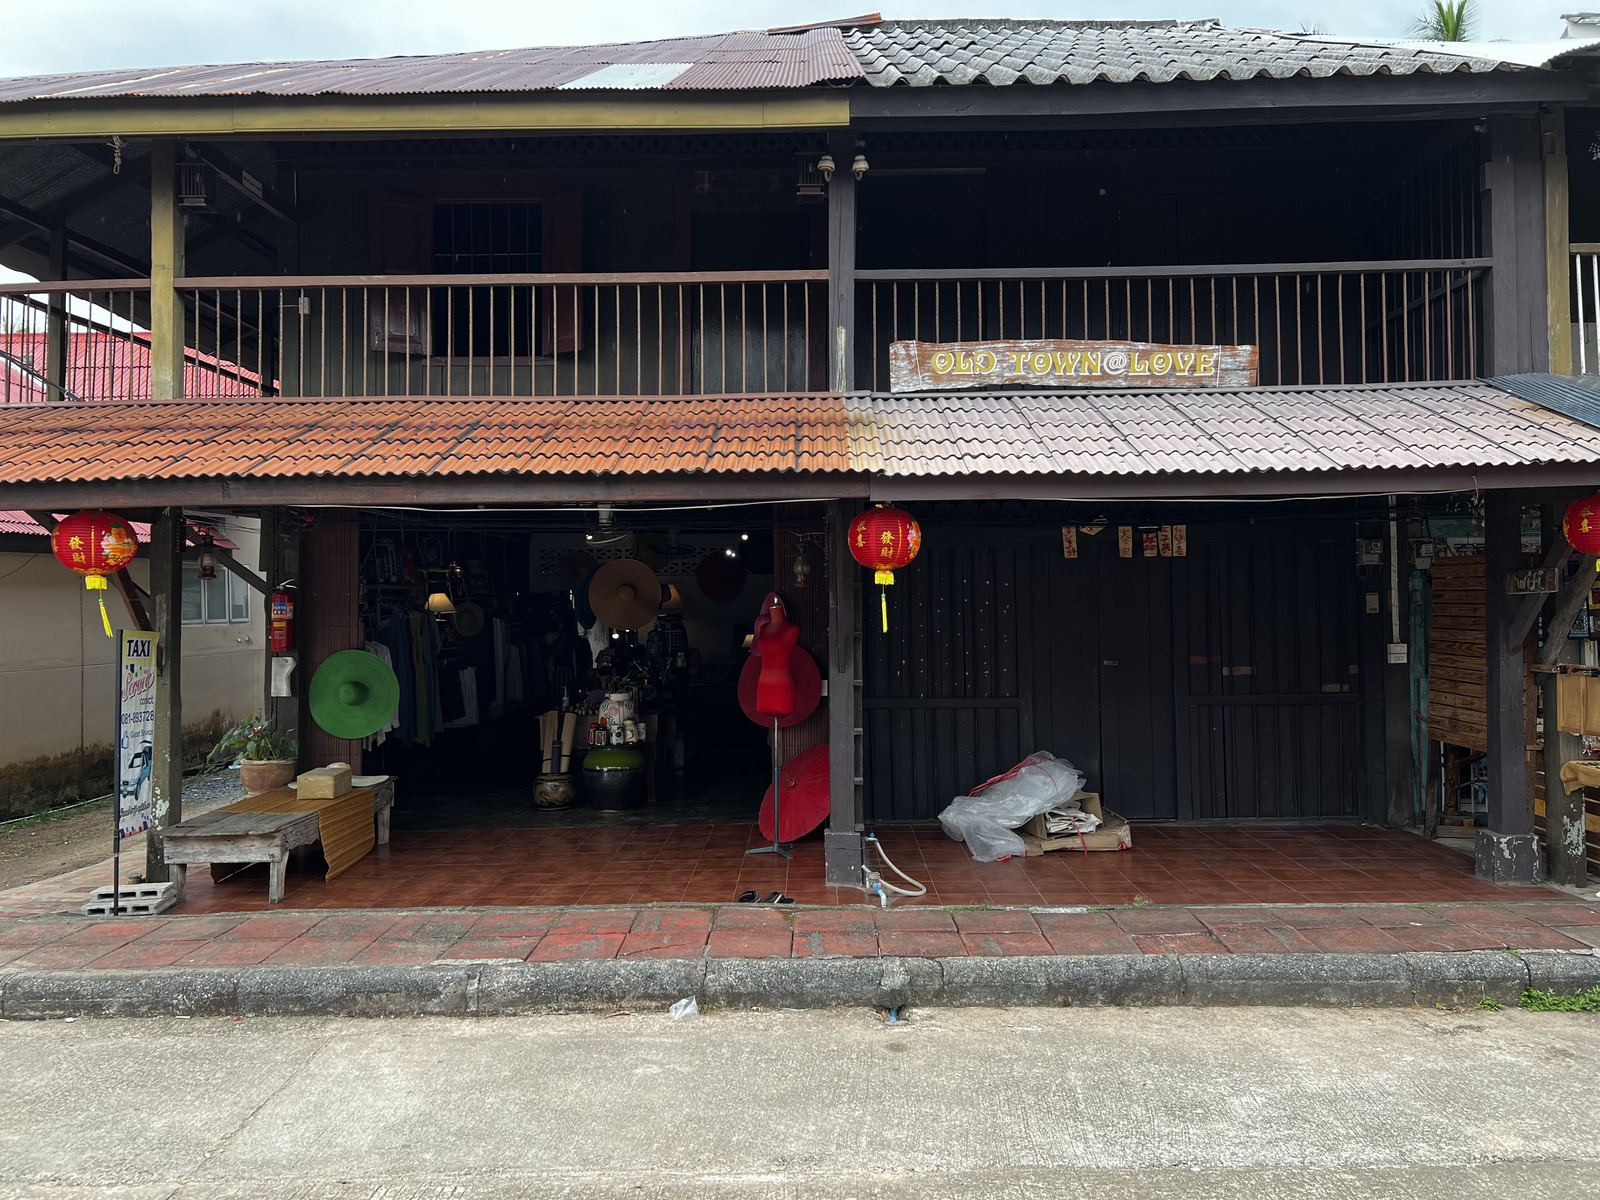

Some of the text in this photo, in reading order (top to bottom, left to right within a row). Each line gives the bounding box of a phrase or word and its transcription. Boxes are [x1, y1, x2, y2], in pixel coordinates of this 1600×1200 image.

[931, 350, 1217, 376] OLD TOWN@LOVE
[68, 535, 87, 564] 發財
[880, 530, 895, 559] 發財
[126, 639, 151, 657] TAXI
